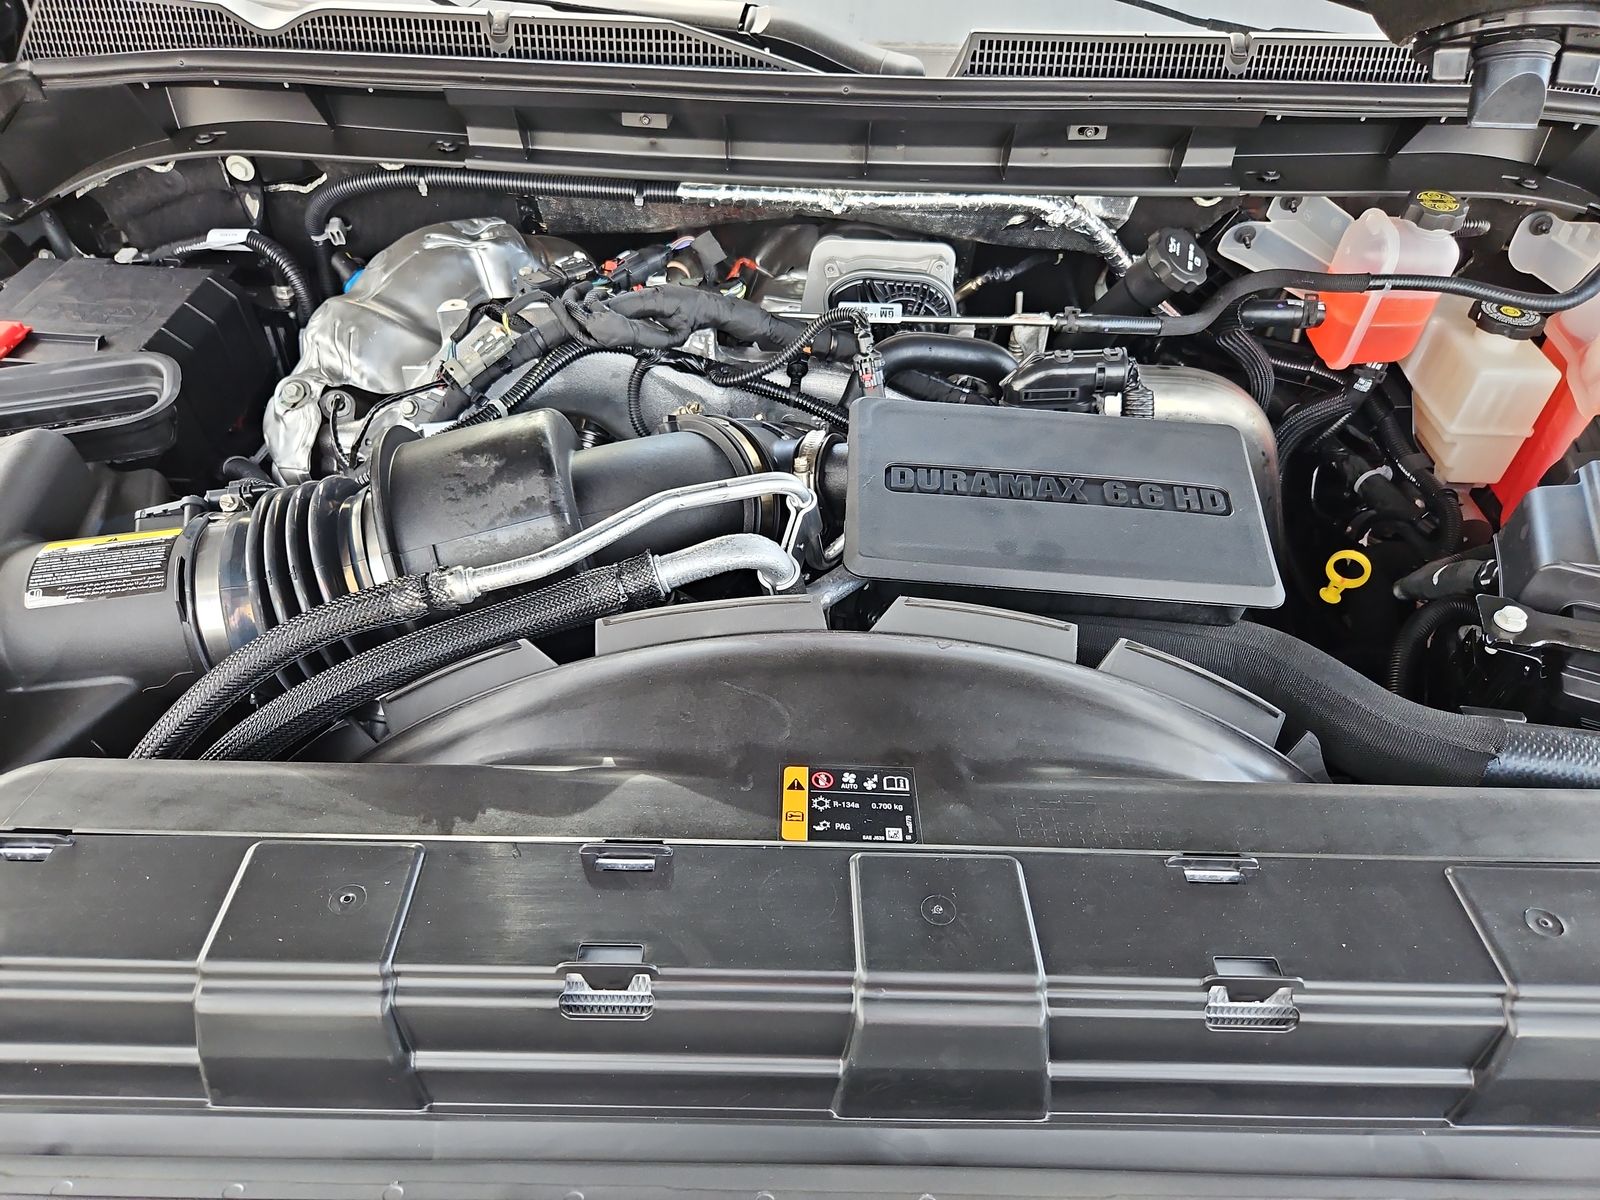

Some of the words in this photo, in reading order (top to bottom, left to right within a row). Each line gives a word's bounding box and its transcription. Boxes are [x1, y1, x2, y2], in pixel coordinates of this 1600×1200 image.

[880, 310, 894, 318] GM
[890, 466, 1089, 503] DURAMAX
[1103, 480, 1165, 507] 6.6
[1173, 485, 1227, 513] HD
[833, 801, 860, 809] R-134a
[871, 802, 892, 810] 0.700
[893, 803, 903, 811] kg
[835, 820, 851, 831] PAG
